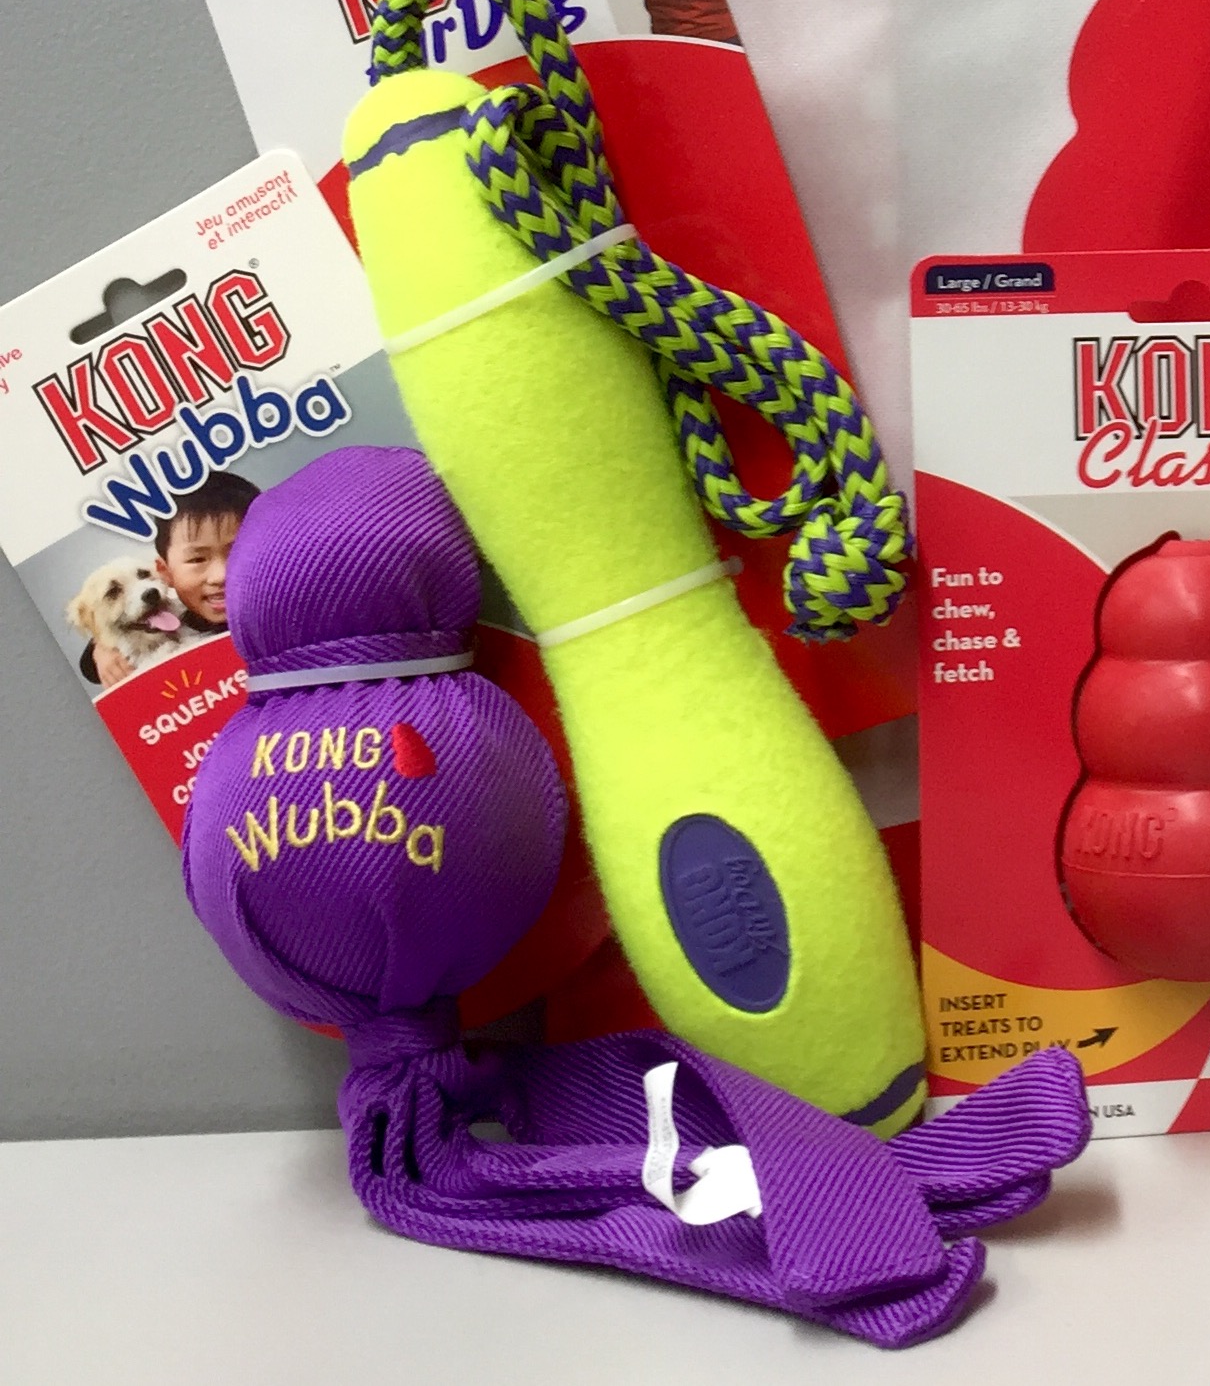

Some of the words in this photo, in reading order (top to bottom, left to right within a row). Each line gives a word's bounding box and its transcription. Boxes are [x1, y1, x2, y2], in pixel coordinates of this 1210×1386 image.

[196, 213, 223, 236] Jeu
[226, 170, 292, 217] amusant
[208, 234, 225, 250] et
[227, 185, 298, 237] interactif
[937, 274, 980, 292] Large
[994, 272, 1043, 288] Grand
[31, 269, 291, 476] KONG
[85, 372, 349, 540] Wubba
[931, 567, 974, 588] Fun
[978, 566, 1003, 586] to
[931, 598, 996, 620] chew,
[932, 629, 998, 652] chase
[1002, 627, 1022, 648] &
[933, 660, 995, 683] fetch
[138, 669, 249, 745] SQUEAKS
[252, 727, 383, 778] KONG
[225, 779, 445, 874] Wubba
[939, 993, 1008, 1013] INSERT
[940, 1018, 1013, 1038] TREATS
[1014, 1016, 1044, 1033] TO
[940, 1043, 1019, 1063] EXTEND
[1102, 1104, 1136, 1119] USA
